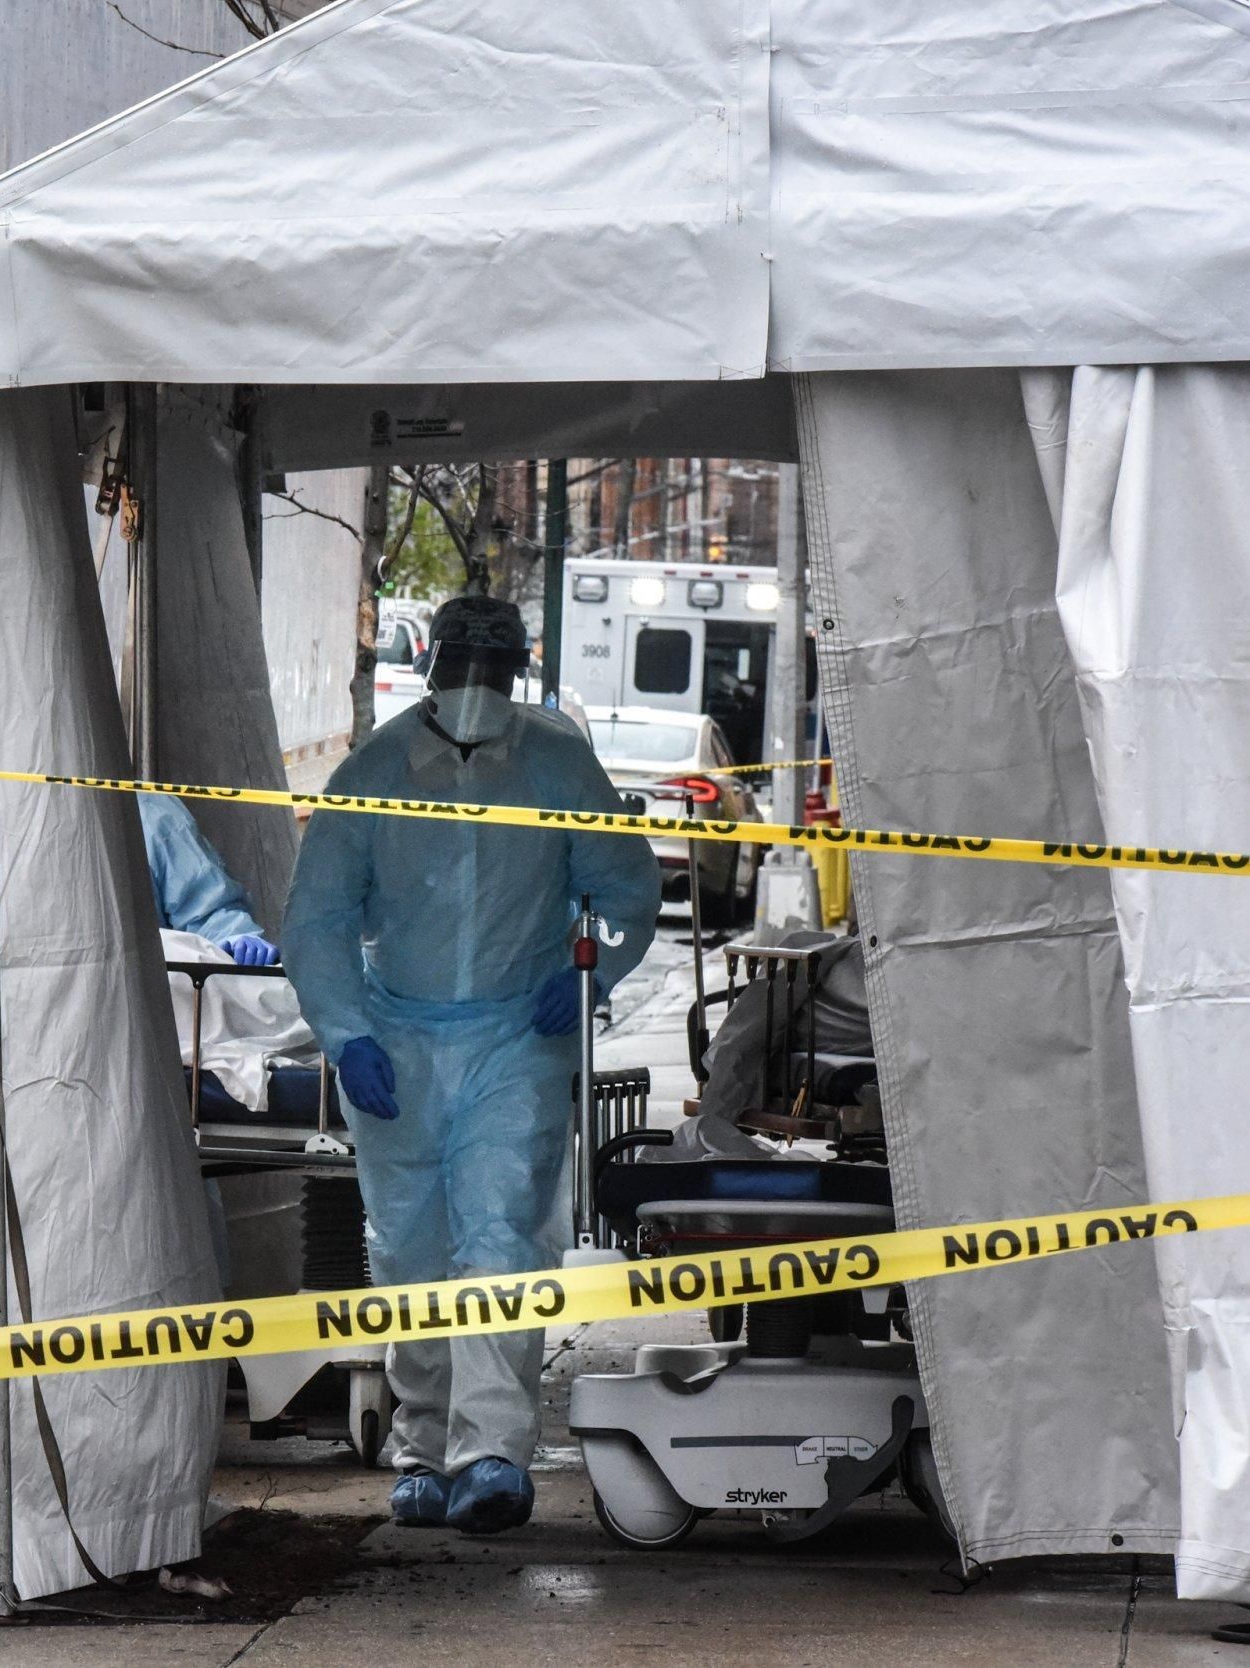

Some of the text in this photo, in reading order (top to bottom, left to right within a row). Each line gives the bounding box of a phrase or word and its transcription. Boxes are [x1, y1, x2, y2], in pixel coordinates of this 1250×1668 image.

[10, 1308, 255, 1369] CAUTION
[316, 1278, 566, 1339] CAUTION
[627, 1244, 880, 1307] CAUTION
[942, 1209, 1198, 1268] CAUTION
[725, 1487, 788, 1505] stryker
